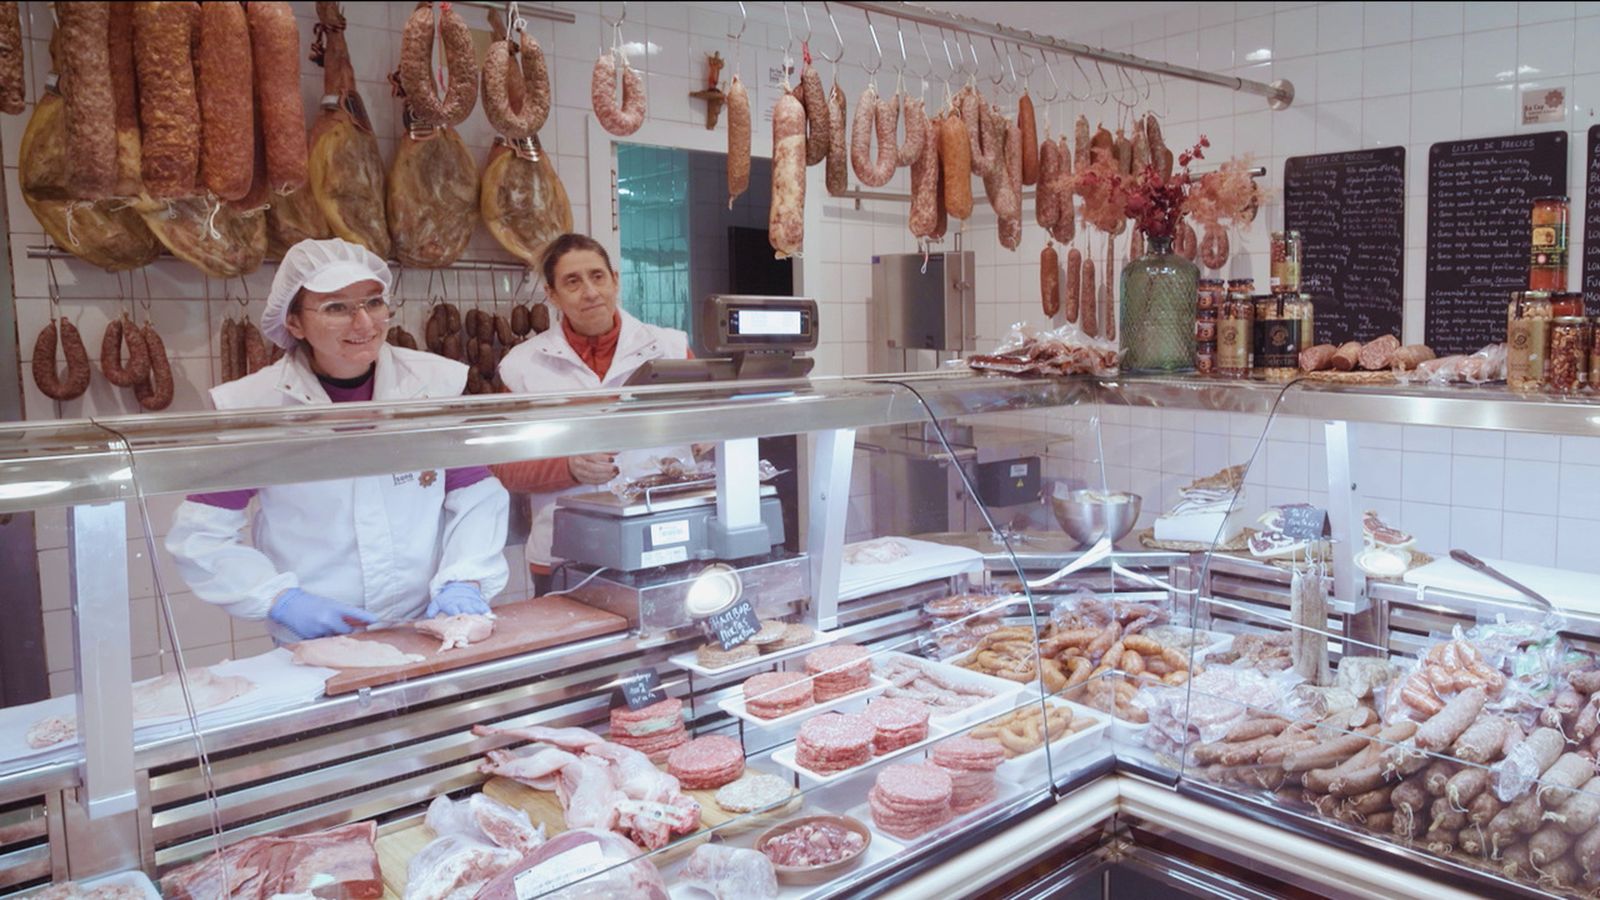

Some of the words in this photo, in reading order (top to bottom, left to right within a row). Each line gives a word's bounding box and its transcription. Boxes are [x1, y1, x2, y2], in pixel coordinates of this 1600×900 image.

[1451, 143, 1479, 153] LISTA
[1484, 142, 1495, 150] DE
[1500, 138, 1535, 149] PRECIOS
